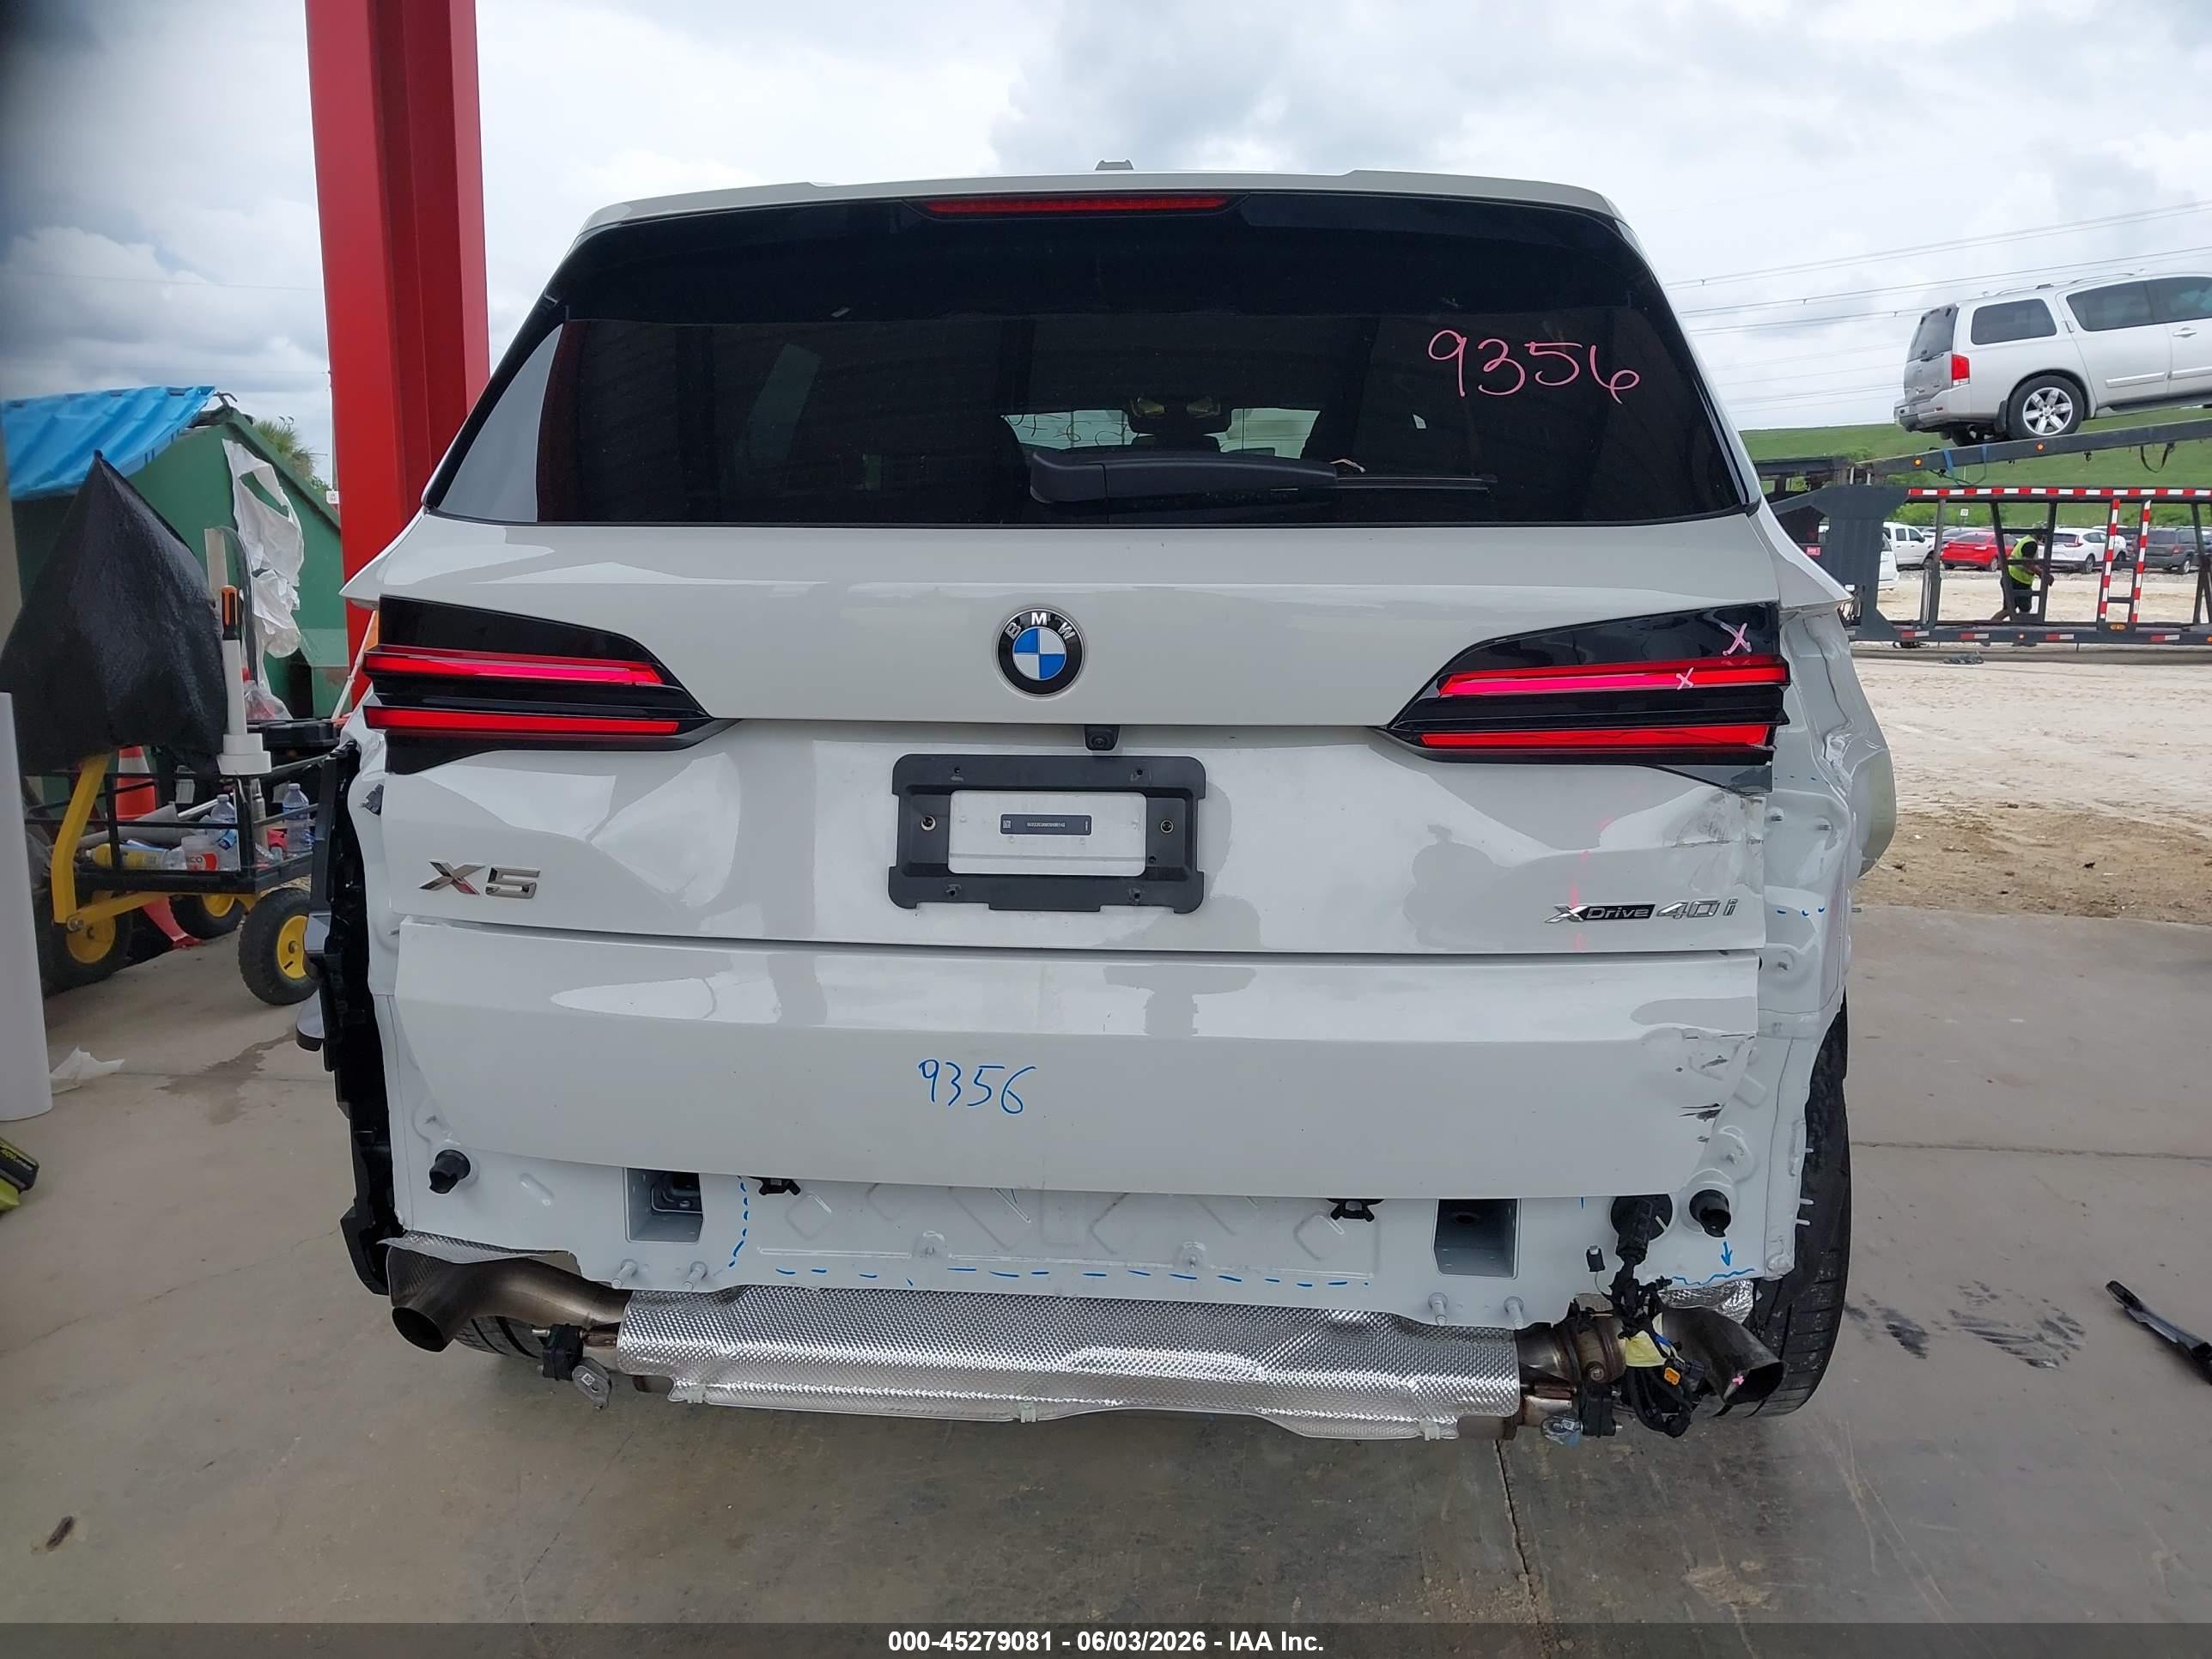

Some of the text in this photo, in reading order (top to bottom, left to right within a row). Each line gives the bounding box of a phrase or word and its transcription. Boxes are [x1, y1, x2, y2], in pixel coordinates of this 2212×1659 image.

[1428, 329, 1640, 404] 9356
[1004, 611, 1076, 641] BMW
[418, 859, 541, 900] X5
[918, 1058, 1037, 1115] 9356
